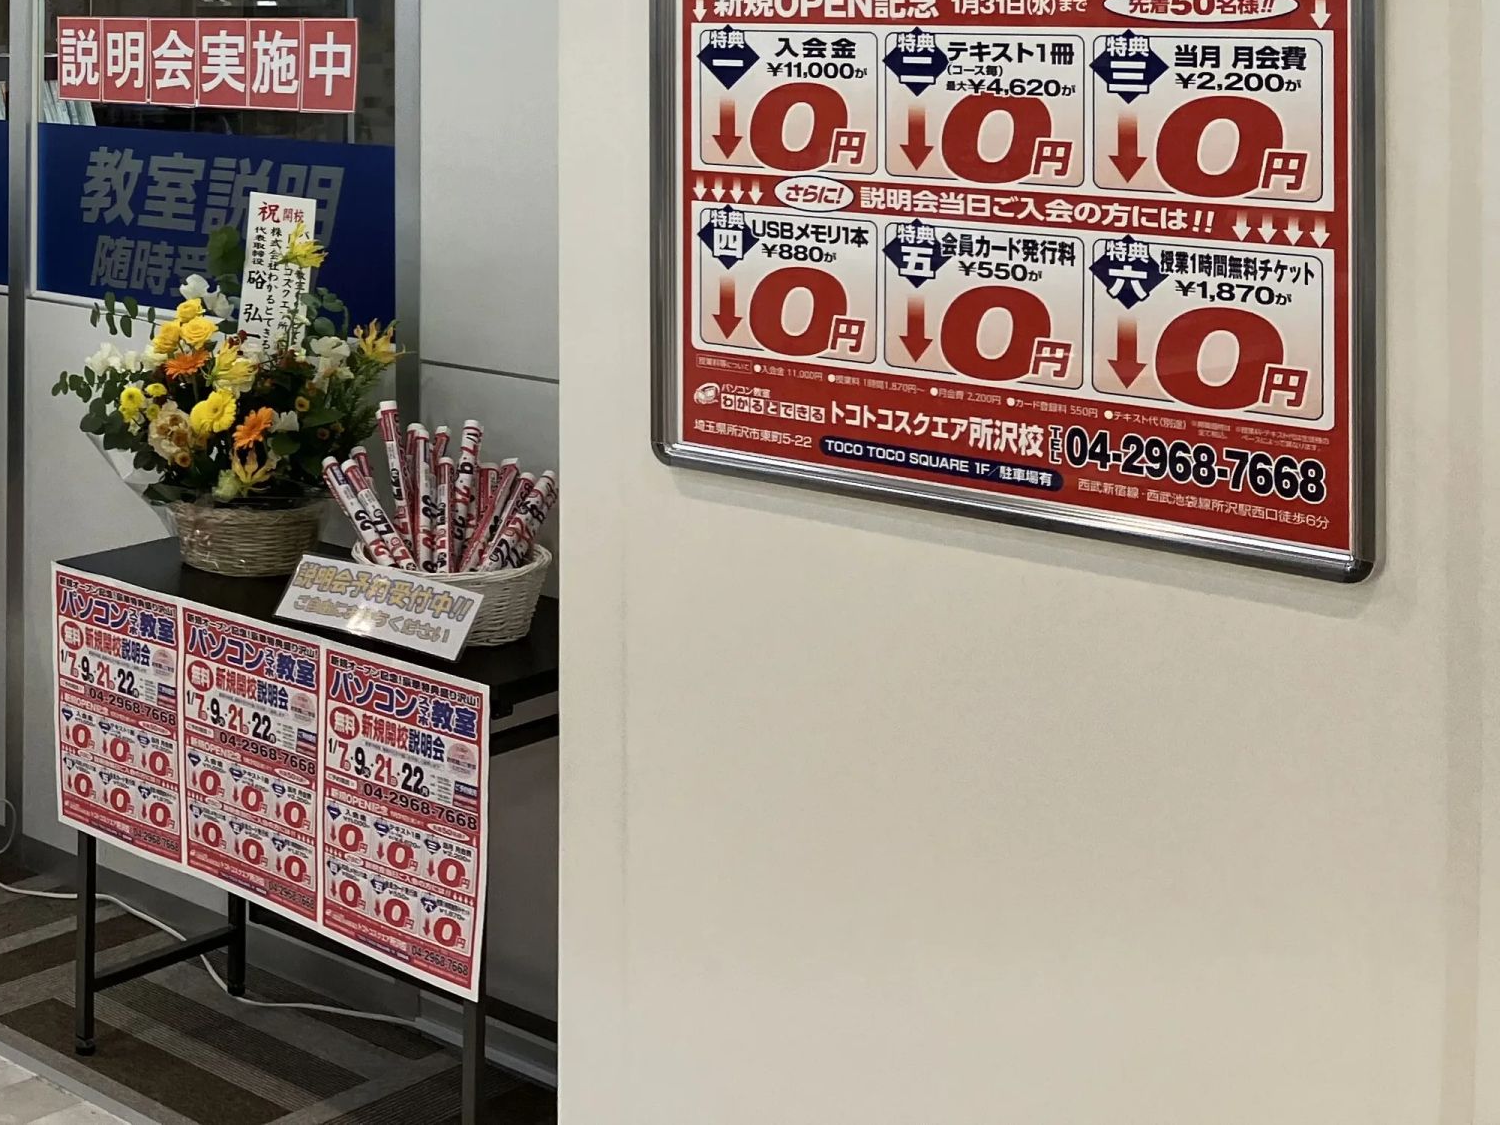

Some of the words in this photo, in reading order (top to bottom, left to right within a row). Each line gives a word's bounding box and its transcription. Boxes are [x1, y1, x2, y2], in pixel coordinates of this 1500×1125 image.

[710, 30, 745, 49] 特典
[775, 37, 857, 59] 入会金
[898, 33, 936, 53] 特典
[1106, 36, 1150, 57] 特典
[59, 27, 353, 97] 説明会実施中
[947, 41, 1075, 65] テキスト1冊
[784, 184, 845, 205] さらに!
[257, 201, 282, 224] 祝
[710, 209, 745, 229] 特典
[897, 224, 936, 246] 特典
[941, 232, 1075, 267] 会員カード発行料
[1106, 241, 1150, 263] 特典
[720, 393, 826, 424] わかるとできる
[831, 400, 1044, 458] トコトコスクエア所沢校
[825, 439, 863, 456] TOCO
[866, 446, 905, 463] TOCO
[909, 453, 969, 473] SQUARE
[1065, 425, 1326, 505] 04-2968-7668
[88, 687, 177, 727] 04-2968-7668
[219, 731, 316, 776] 04-2968-7668
[362, 781, 479, 832] 04-2968-7668
